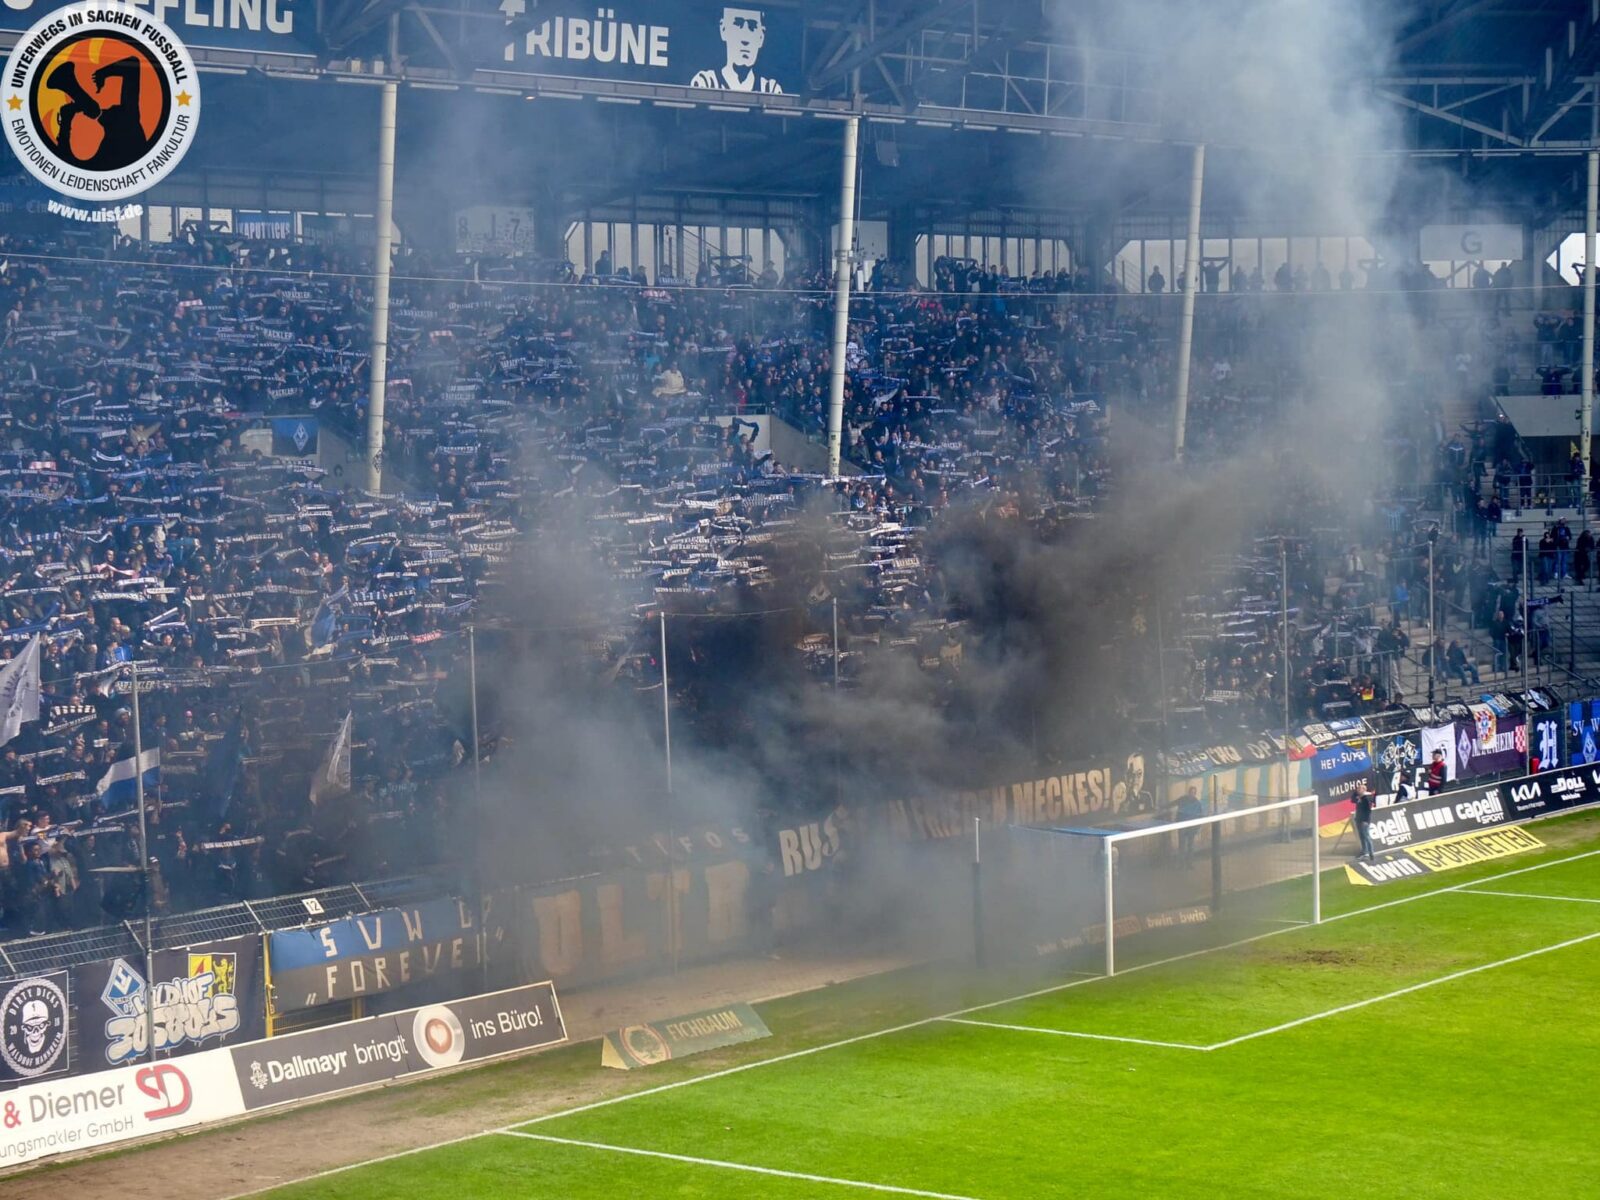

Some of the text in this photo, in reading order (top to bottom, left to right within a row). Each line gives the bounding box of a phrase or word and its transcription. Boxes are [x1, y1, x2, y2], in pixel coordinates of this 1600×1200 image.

[1460, 230, 1483, 255] G
[1012, 767, 1112, 825] MECKES!
[1455, 788, 1504, 823] capelli
[1369, 807, 1413, 844] apelli
[1481, 812, 1505, 825] SPORT
[1360, 826, 1537, 881] bwin SPORTWETTEN
[1386, 832, 1413, 846] SPORT
[9, 987, 59, 1016] DIRTY DICKS
[666, 1010, 743, 1041] EICHBAUM
[267, 1051, 348, 1083] Dallmayr
[470, 1015, 496, 1039] ins
[500, 1005, 544, 1033] Büro!
[4, 1083, 125, 1129] & Diemer
[86, 1115, 135, 1138] GmbH
